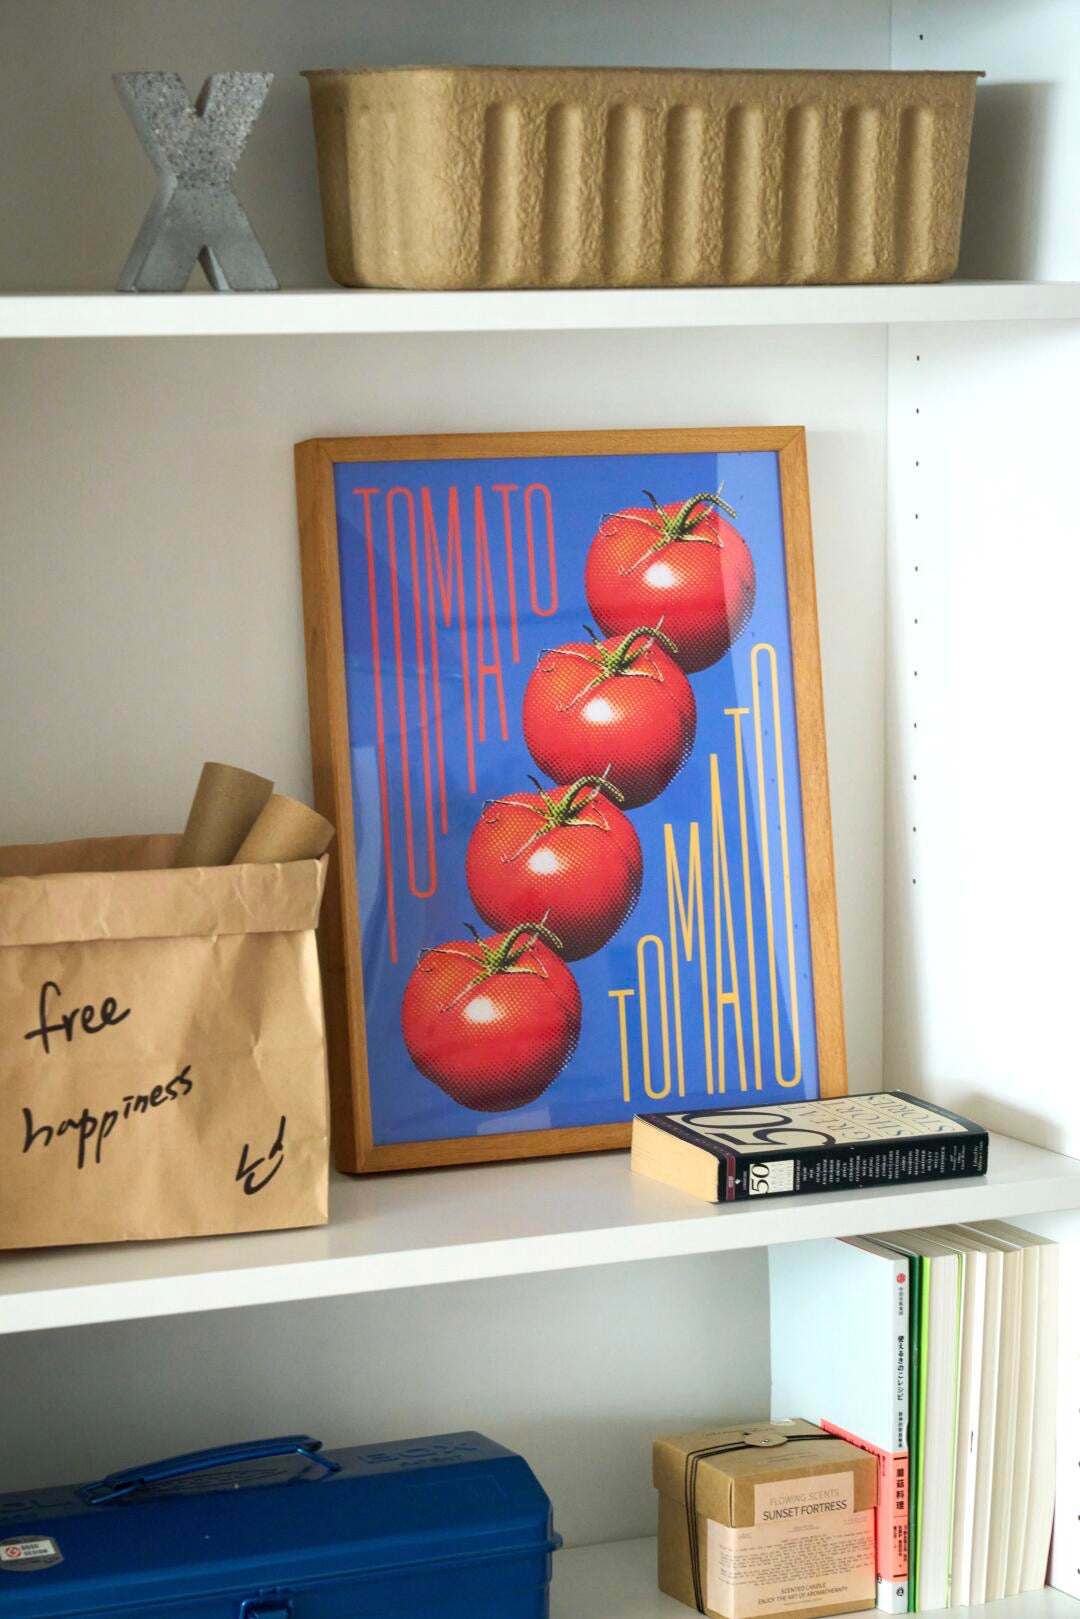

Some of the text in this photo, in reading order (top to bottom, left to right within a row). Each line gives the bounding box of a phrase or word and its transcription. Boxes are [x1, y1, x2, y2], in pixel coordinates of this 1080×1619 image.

[353, 483, 559, 965] TOMATO
[608, 643, 803, 1104] TOMATO
[25, 980, 131, 1054] free
[22, 1064, 194, 1170] happiness
[681, 1110, 837, 1147] 50
[778, 1104, 871, 1141] GREAT
[816, 1101, 914, 1137] SHORT
[866, 1094, 957, 1132] STORIES
[750, 1163, 770, 1195] 50
[762, 1499, 848, 1521] SUNSET FORTRESS
[769, 1489, 840, 1506] FLOWING SCENTS
